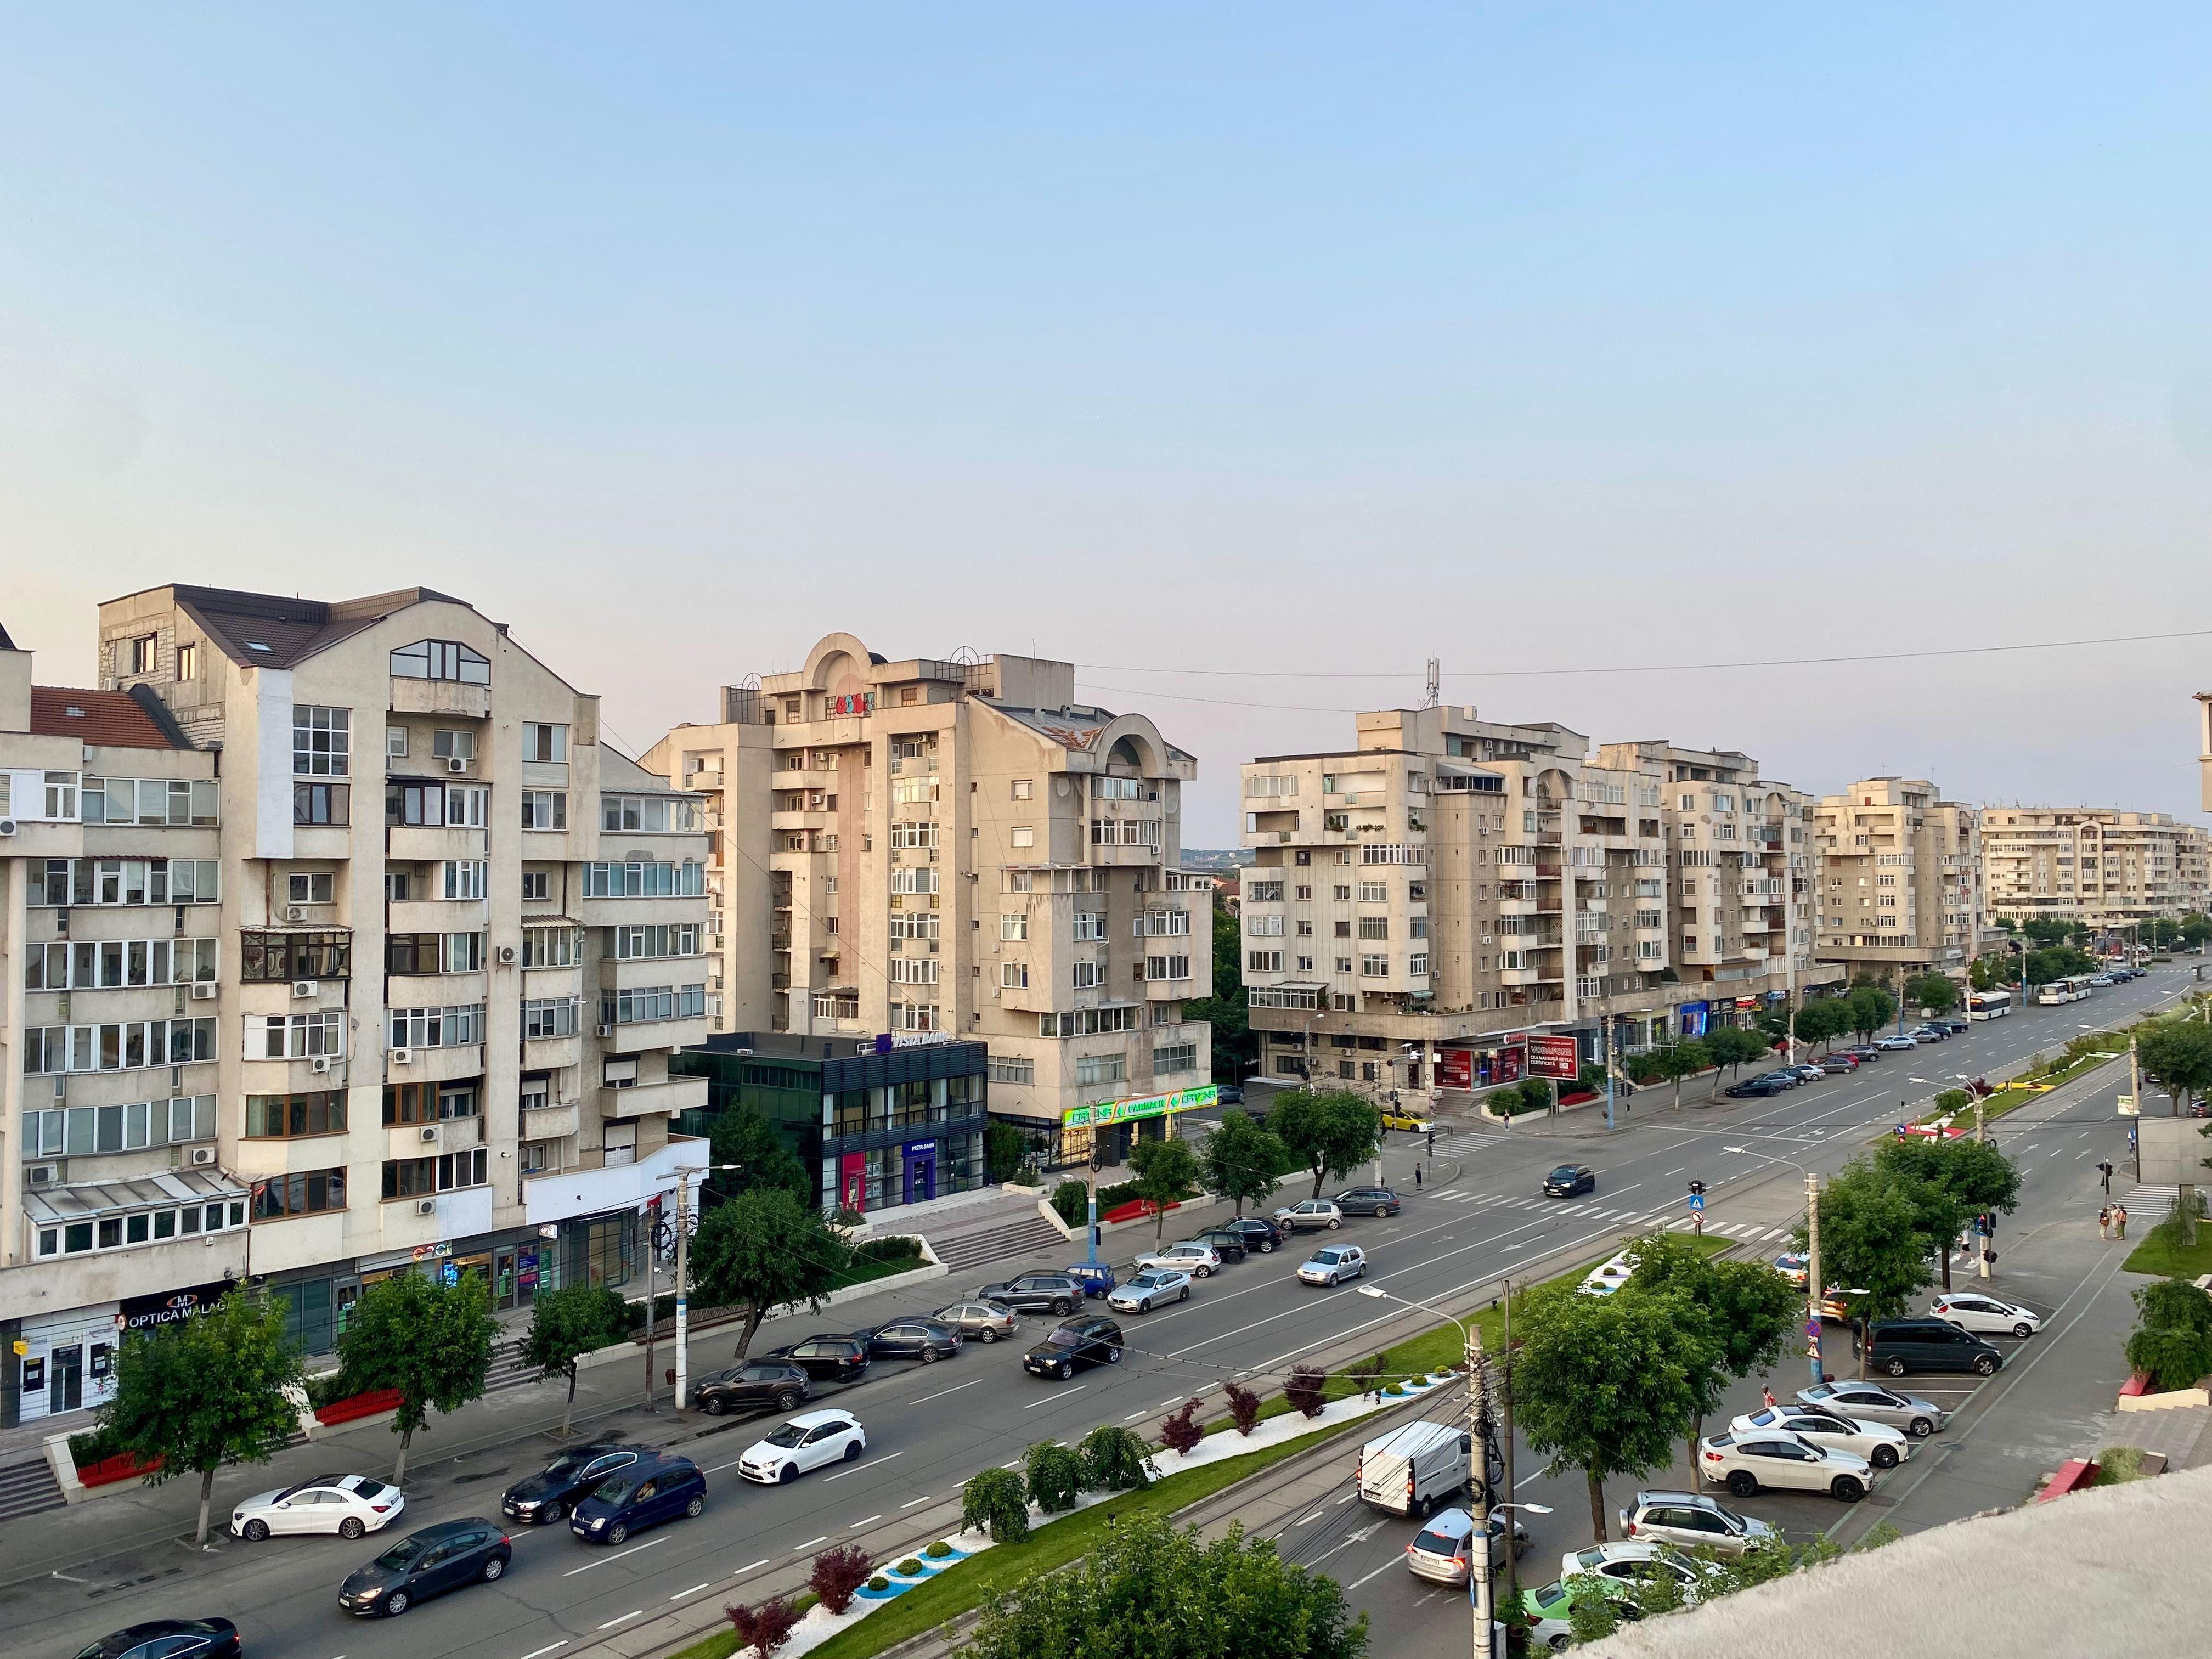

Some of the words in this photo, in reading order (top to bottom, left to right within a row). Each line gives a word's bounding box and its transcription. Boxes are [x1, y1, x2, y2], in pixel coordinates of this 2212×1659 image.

[893, 1034, 921, 1047] VISTA
[922, 1031, 949, 1045] BANK
[1531, 1046, 1572, 1056] VODAFONE
[129, 1310, 179, 1328] OPTICA
[182, 1302, 230, 1318] MALAG
